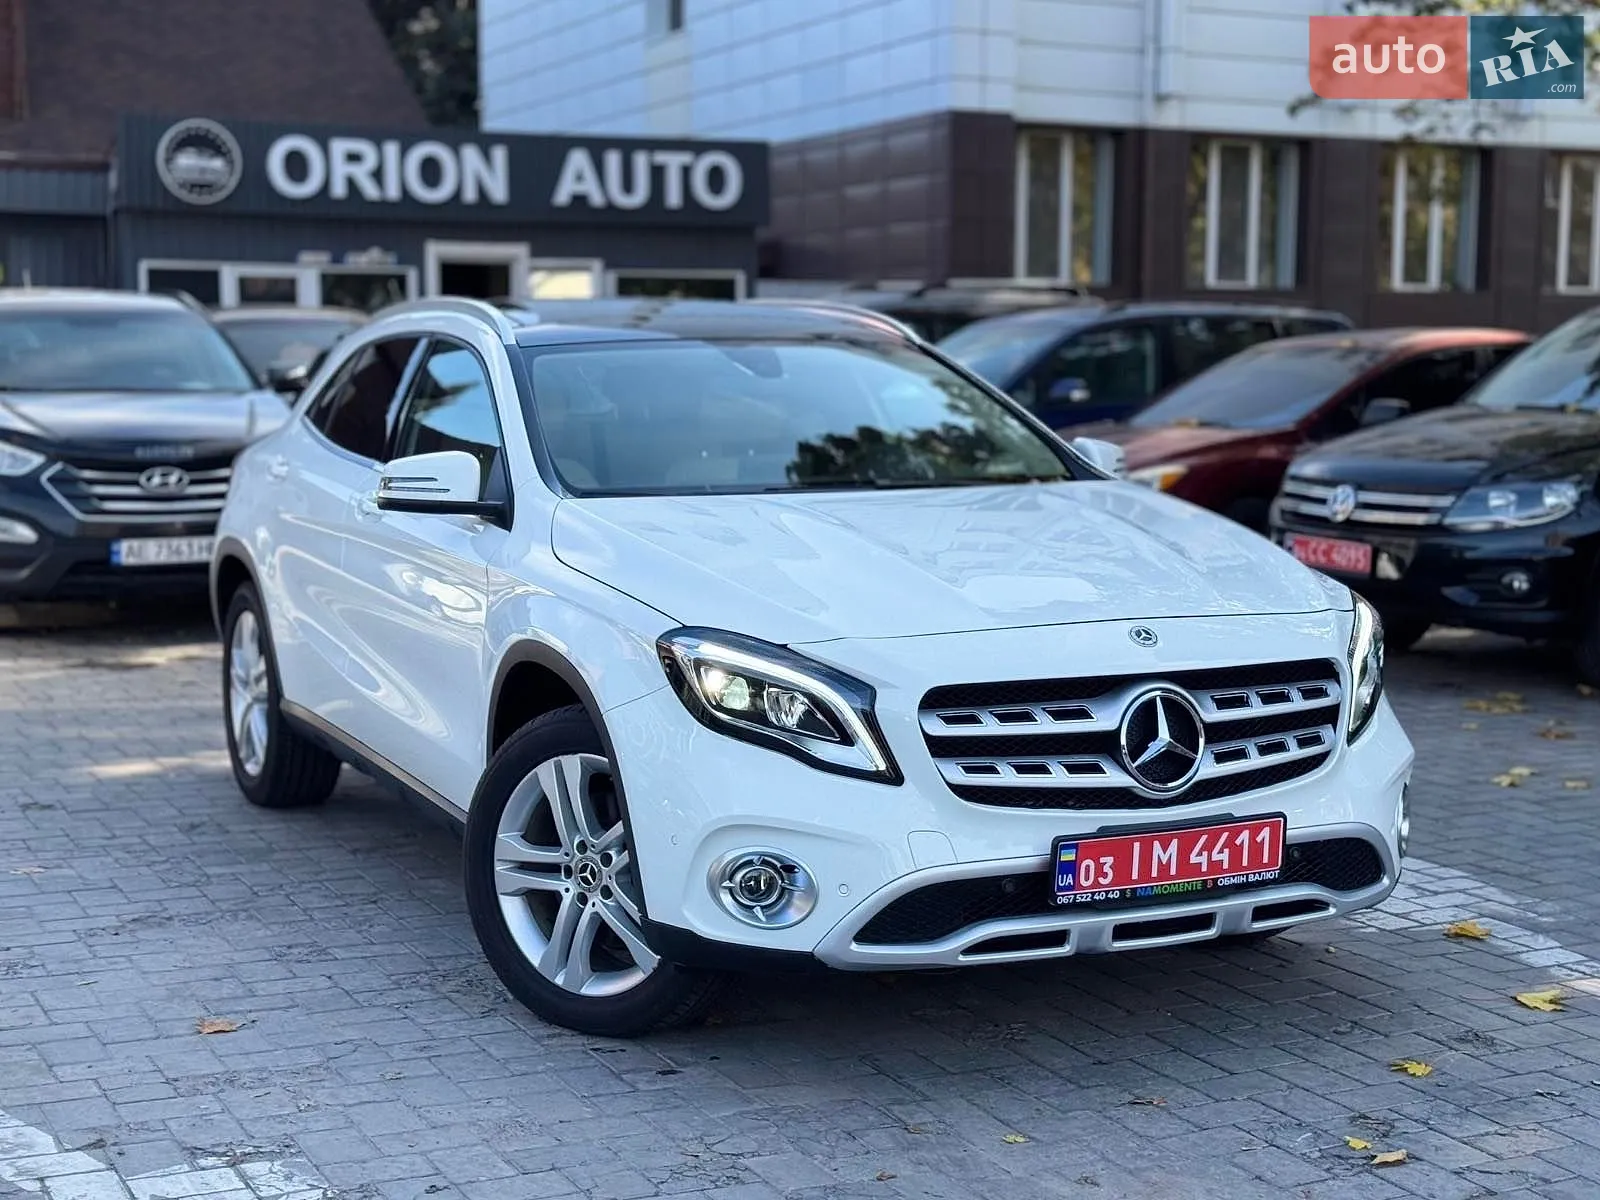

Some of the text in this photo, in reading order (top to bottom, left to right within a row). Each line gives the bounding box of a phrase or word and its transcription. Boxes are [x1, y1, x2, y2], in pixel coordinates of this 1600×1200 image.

[266, 133, 510, 206] ORION
[551, 147, 743, 212] AUTO
[1079, 826, 1273, 887] 03 IM 4411
[1058, 873, 1074, 886] UA
[1217, 870, 1280, 887] ОБМІН ВАЛЮТ
[1057, 890, 1120, 904] 067 522 40 40
[1136, 880, 1203, 897] NAMOMENTE
